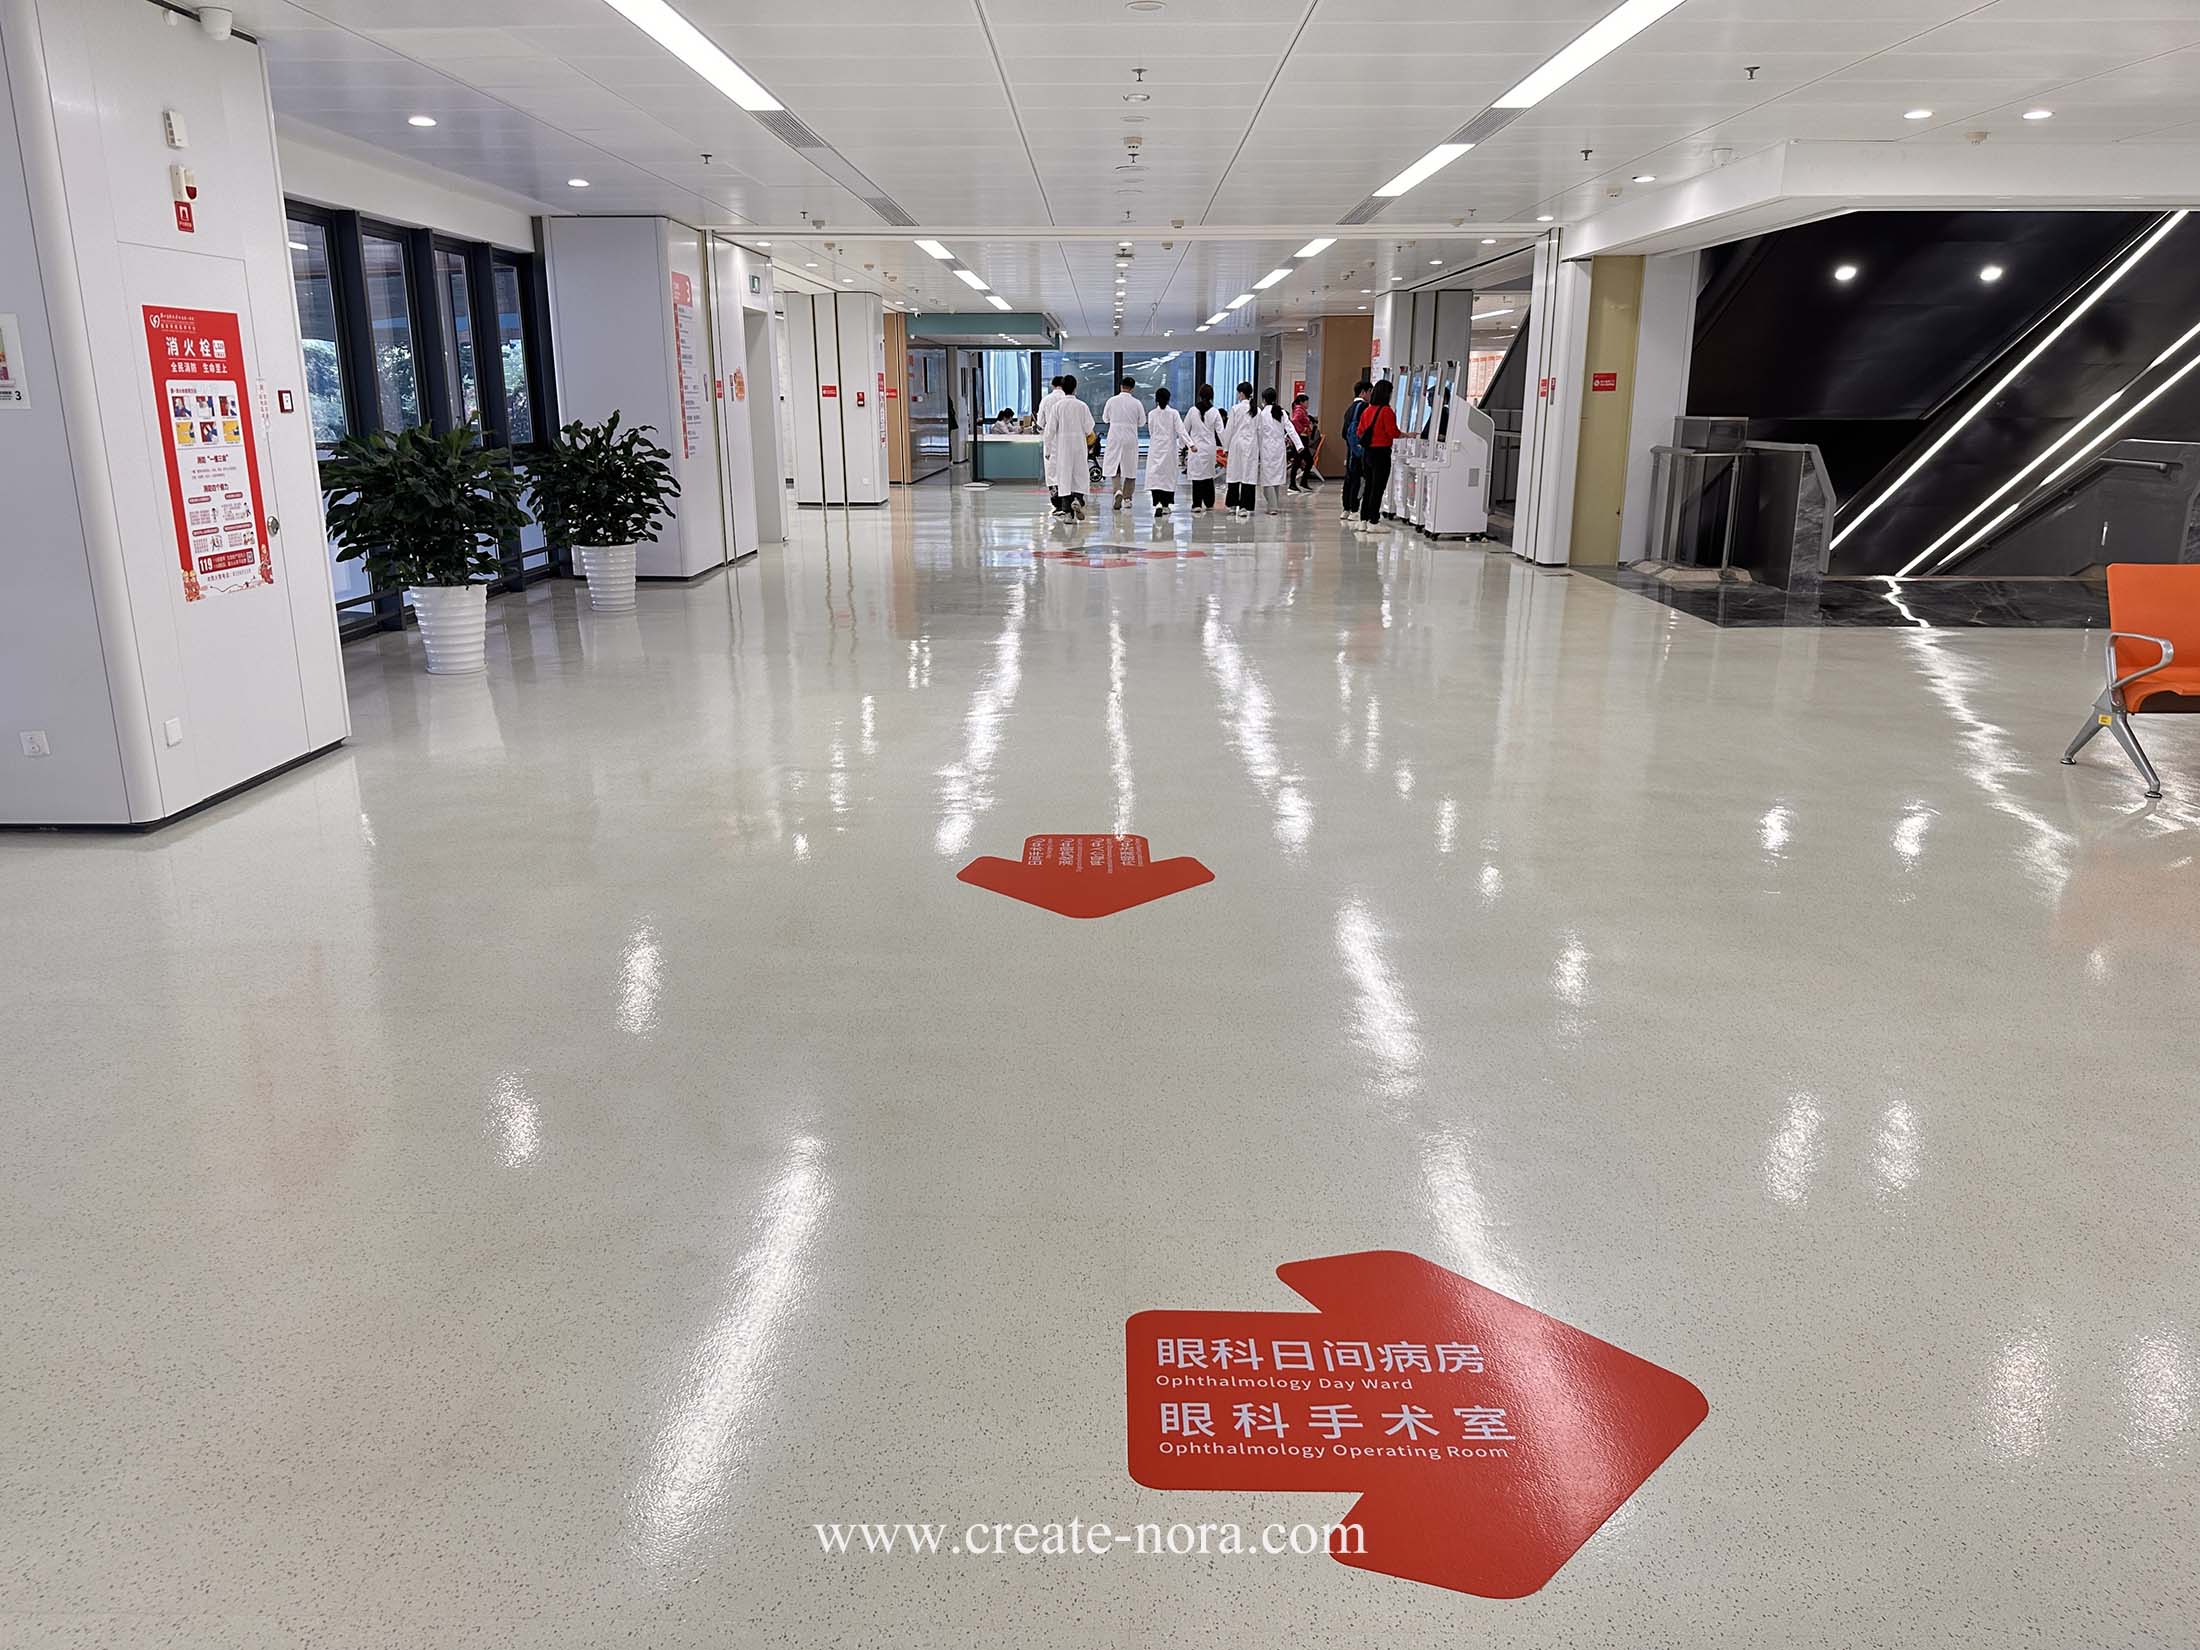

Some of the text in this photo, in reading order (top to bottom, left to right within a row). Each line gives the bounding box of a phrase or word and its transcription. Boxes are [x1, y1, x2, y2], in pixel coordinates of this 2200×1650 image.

[165, 336, 212, 357] 消火栓
[202, 363, 228, 374] 生命至上
[14, 390, 22, 401] 3
[199, 557, 213, 572] 119
[1156, 1338, 1486, 1374] 眼科日间病房
[1156, 1375, 1413, 1392] Ophthalmology Day Ward
[1159, 1401, 1516, 1441] 眼科手术室
[1158, 1441, 1509, 1461] Ophthalmology Operating Room
